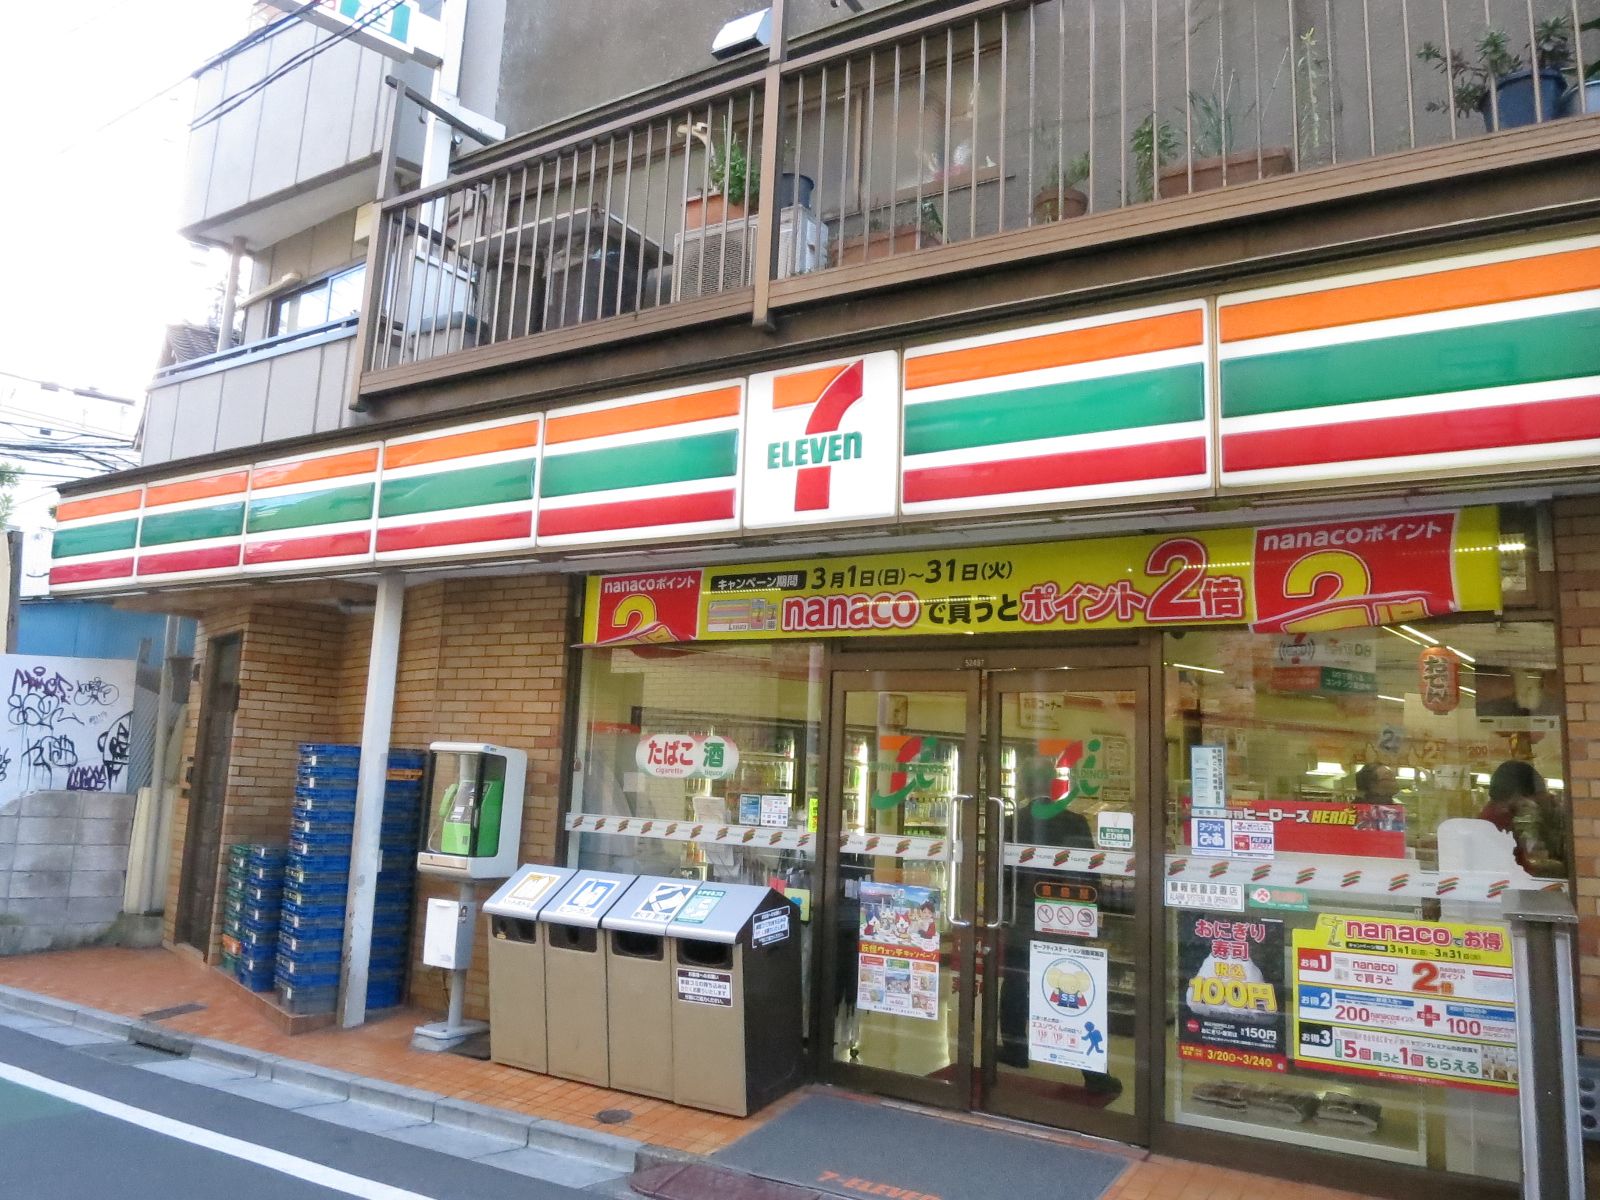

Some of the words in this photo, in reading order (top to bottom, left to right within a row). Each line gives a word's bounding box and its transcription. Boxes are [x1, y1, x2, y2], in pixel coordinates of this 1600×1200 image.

[717, 574, 798, 590] キャンペーン期間
[648, 740, 693, 766] たばこ
[703, 742, 725, 767] 酒
[655, 767, 684, 775] cigarette
[1194, 919, 1266, 943] おにぎり
[1211, 940, 1249, 961] 寿司
[1352, 960, 1396, 972] nanaco
[1355, 973, 1394, 986] で買うと
[1189, 976, 1278, 1013] 100円
[1335, 1005, 1369, 1022] 200
[1447, 1018, 1481, 1036] 100
